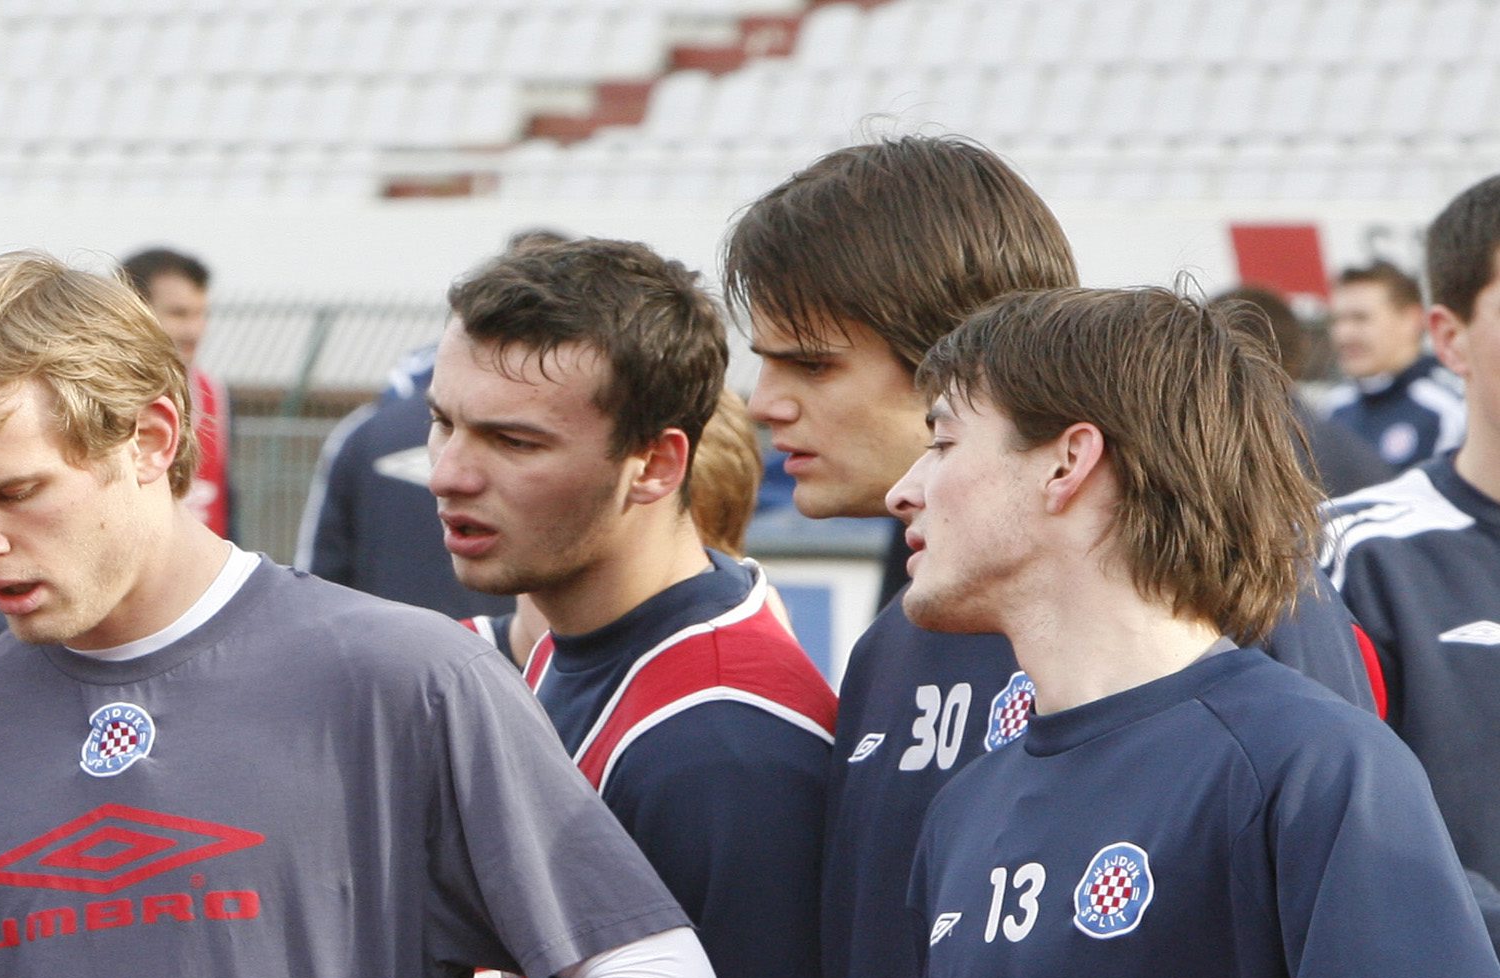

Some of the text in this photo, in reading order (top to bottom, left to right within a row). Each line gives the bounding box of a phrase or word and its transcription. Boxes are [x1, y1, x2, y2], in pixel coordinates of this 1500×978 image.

[92, 708, 144, 738] HAJDUK
[899, 682, 972, 771] 30
[1093, 854, 1141, 880] HAJDUK
[984, 862, 1046, 943] 13
[1081, 906, 1127, 928] SPLIT
